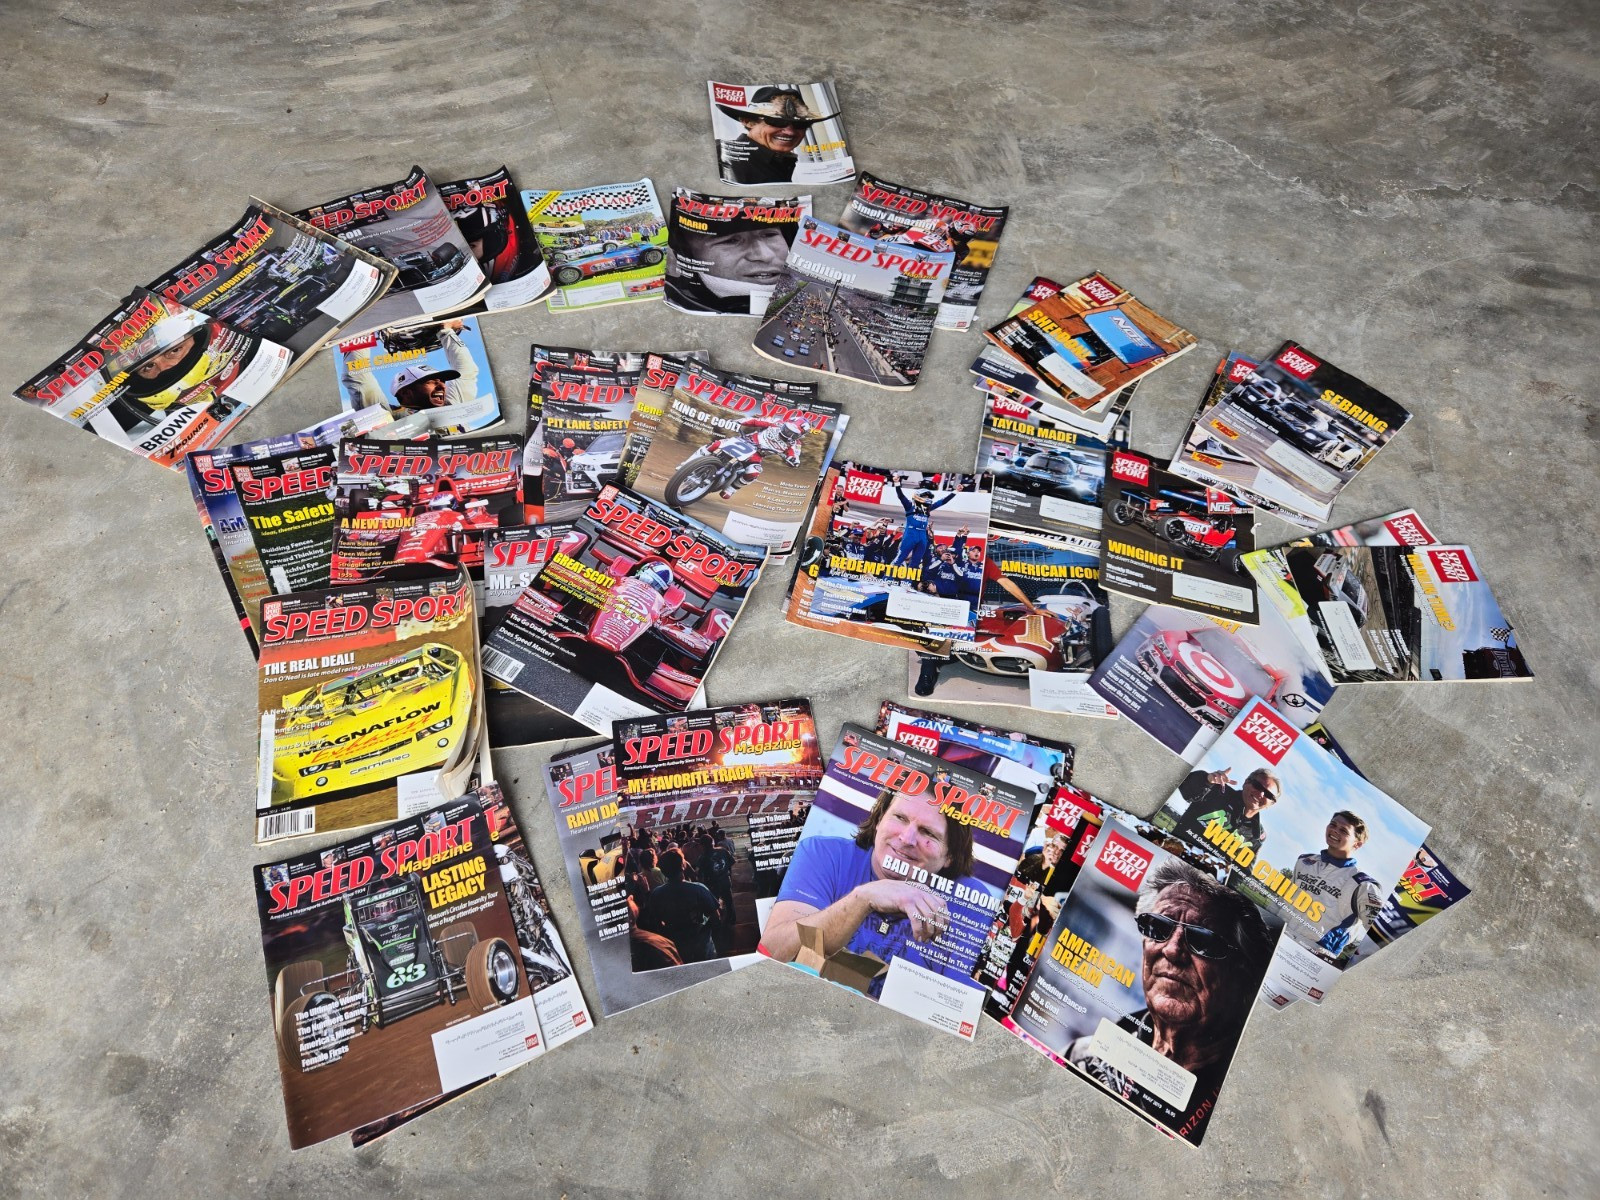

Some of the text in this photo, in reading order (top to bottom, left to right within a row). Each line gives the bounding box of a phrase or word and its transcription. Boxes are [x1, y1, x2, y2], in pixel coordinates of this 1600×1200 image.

[715, 88, 744, 96] SPEED
[716, 94, 744, 102] SPORT
[821, 141, 846, 151] KING
[355, 177, 426, 219] SPORT
[394, 193, 427, 212] Magazine
[548, 195, 635, 212] VICTORY LANE
[676, 197, 740, 219] SPEED
[741, 206, 806, 220] SPORT
[861, 184, 998, 229] SPEED SPORT
[679, 216, 708, 231] MARIO
[851, 200, 936, 230] Simply Amazing!
[163, 262, 218, 300] PEED
[215, 216, 273, 269] SPORT
[234, 228, 274, 265] Magazine
[800, 228, 948, 278] SPEED SPORT
[217, 262, 258, 298] MODIFIEDS!
[790, 252, 856, 284] Tradition!
[903, 271, 938, 280] Magazine
[1084, 285, 1110, 301] SPORT
[1086, 280, 1116, 300] SPEED
[121, 309, 164, 349] Magazine
[1028, 309, 1093, 360] SHELDON!
[37, 351, 104, 406] SPEED
[100, 296, 160, 355] SPORT
[346, 348, 427, 372] THE CHAMP!
[1282, 350, 1317, 370] SPEED
[1280, 356, 1313, 375] SPORT
[70, 404, 84, 419] ON
[91, 371, 130, 405] MISSION
[548, 381, 624, 403] SPEED
[683, 373, 756, 413] SPEED
[756, 401, 833, 430] SPORT
[672, 401, 710, 422] KING OF
[995, 402, 1026, 413] SPORT
[1320, 389, 1389, 433] SEBRING
[140, 408, 197, 451] BROWN
[548, 418, 630, 430] PIT LANE SAFETY
[992, 417, 1077, 444] TAYLOR MADE!
[345, 454, 432, 476] SPEED
[436, 449, 516, 475] SPORT
[722, 441, 754, 457] 2
[472, 467, 509, 475] Magazine
[1114, 466, 1148, 479] SPORT
[1115, 458, 1148, 471] SPEED
[846, 485, 881, 497] SPORT
[848, 474, 882, 488] SPEED
[250, 502, 334, 530] The Safety
[1210, 502, 1233, 512] NOS
[341, 517, 416, 529] A NEW LOOK!
[261, 539, 314, 554] Building Fences
[587, 499, 672, 548] SPEED
[667, 536, 756, 584] SPORT
[1108, 540, 1184, 570] WINGING IT
[266, 548, 324, 565] Forward Thinking
[552, 552, 616, 588] GREAT SCOT!
[830, 556, 922, 581] REDEMPTION!
[1001, 560, 1100, 580] AMERICAN ICON
[1436, 551, 1460, 581] SPORT
[1446, 552, 1470, 581] SPEED
[489, 573, 516, 590] Mr.
[264, 585, 466, 641] SPEED SPORT
[510, 613, 560, 642] The Go Guy
[499, 627, 555, 657] Does Speed Matter?
[264, 652, 355, 675] THE REAL DEAL!
[342, 664, 365, 673] racing's
[366, 660, 387, 668] hottest
[298, 702, 441, 758] MAGNAFLOW
[899, 731, 937, 750] SPEED
[1241, 721, 1285, 755] SPORT
[1248, 710, 1293, 747] SPEED
[623, 720, 802, 765] SPEED SPORT
[734, 738, 800, 755] Magazine
[628, 765, 754, 793] MY FAVORITE TRACK
[835, 745, 1024, 832] SPEED SPORT
[567, 808, 600, 830] RAIN
[634, 794, 794, 829] ELDORA
[939, 804, 1010, 838] Magazine
[268, 815, 476, 914] SPEED SPORT
[399, 841, 473, 876] Magazine
[1100, 852, 1144, 884] SPORT
[1105, 839, 1148, 871] SPEED
[422, 856, 486, 892] LASTING
[883, 854, 1003, 912] BAD TO THE BLOOM
[1203, 819, 1326, 923] WILD CHILDS
[428, 874, 486, 910] LEGACY
[591, 898, 603, 906] One
[1317, 880, 1341, 898] Pacific
[595, 912, 611, 923] Open
[605, 924, 618, 935] New
[913, 912, 927, 921] How
[928, 919, 947, 931] Young
[955, 928, 966, 938] Too
[961, 915, 980, 927] Many
[906, 940, 927, 953] What's
[934, 951, 948, 961] Like
[956, 960, 968, 970] The
[1051, 942, 1104, 988] DREAM
[1058, 927, 1136, 988] AMERICAN
[1037, 975, 1087, 1014] Wedding Dance?
[295, 1001, 340, 1021] The Ultimate
[297, 1026, 311, 1036] The
[335, 1027, 355, 1038] Miles
[302, 1045, 349, 1067] Female Firsts
